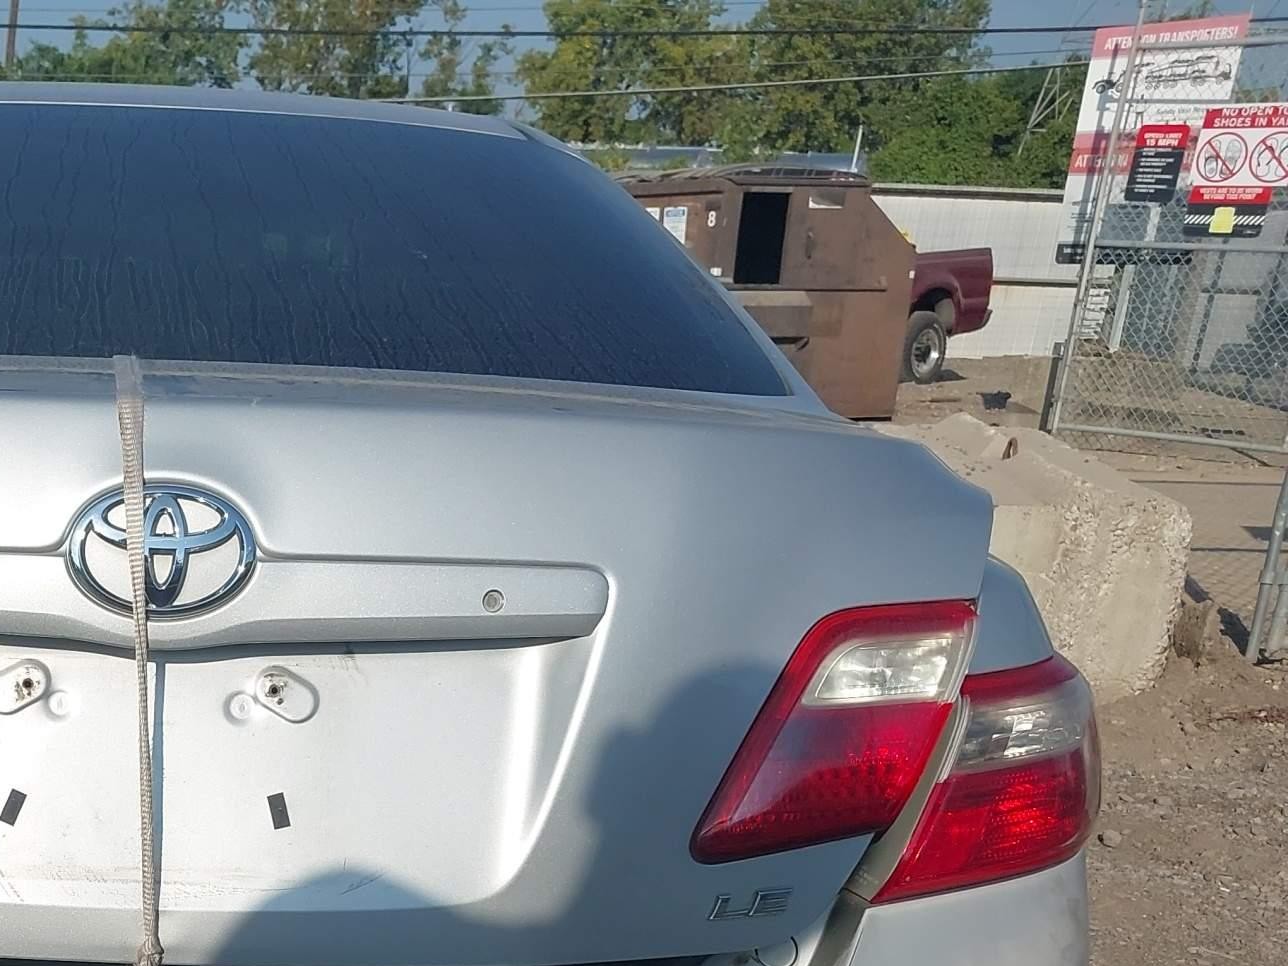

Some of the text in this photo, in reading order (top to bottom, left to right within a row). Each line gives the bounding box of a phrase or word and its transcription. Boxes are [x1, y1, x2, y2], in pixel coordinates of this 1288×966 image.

[1221, 108, 1239, 116] NO
[1241, 106, 1274, 116] OPEN
[1213, 118, 1252, 127] SHOES
[1254, 117, 1268, 126] IN
[708, 211, 716, 227] 8
[708, 888, 793, 920] LE
